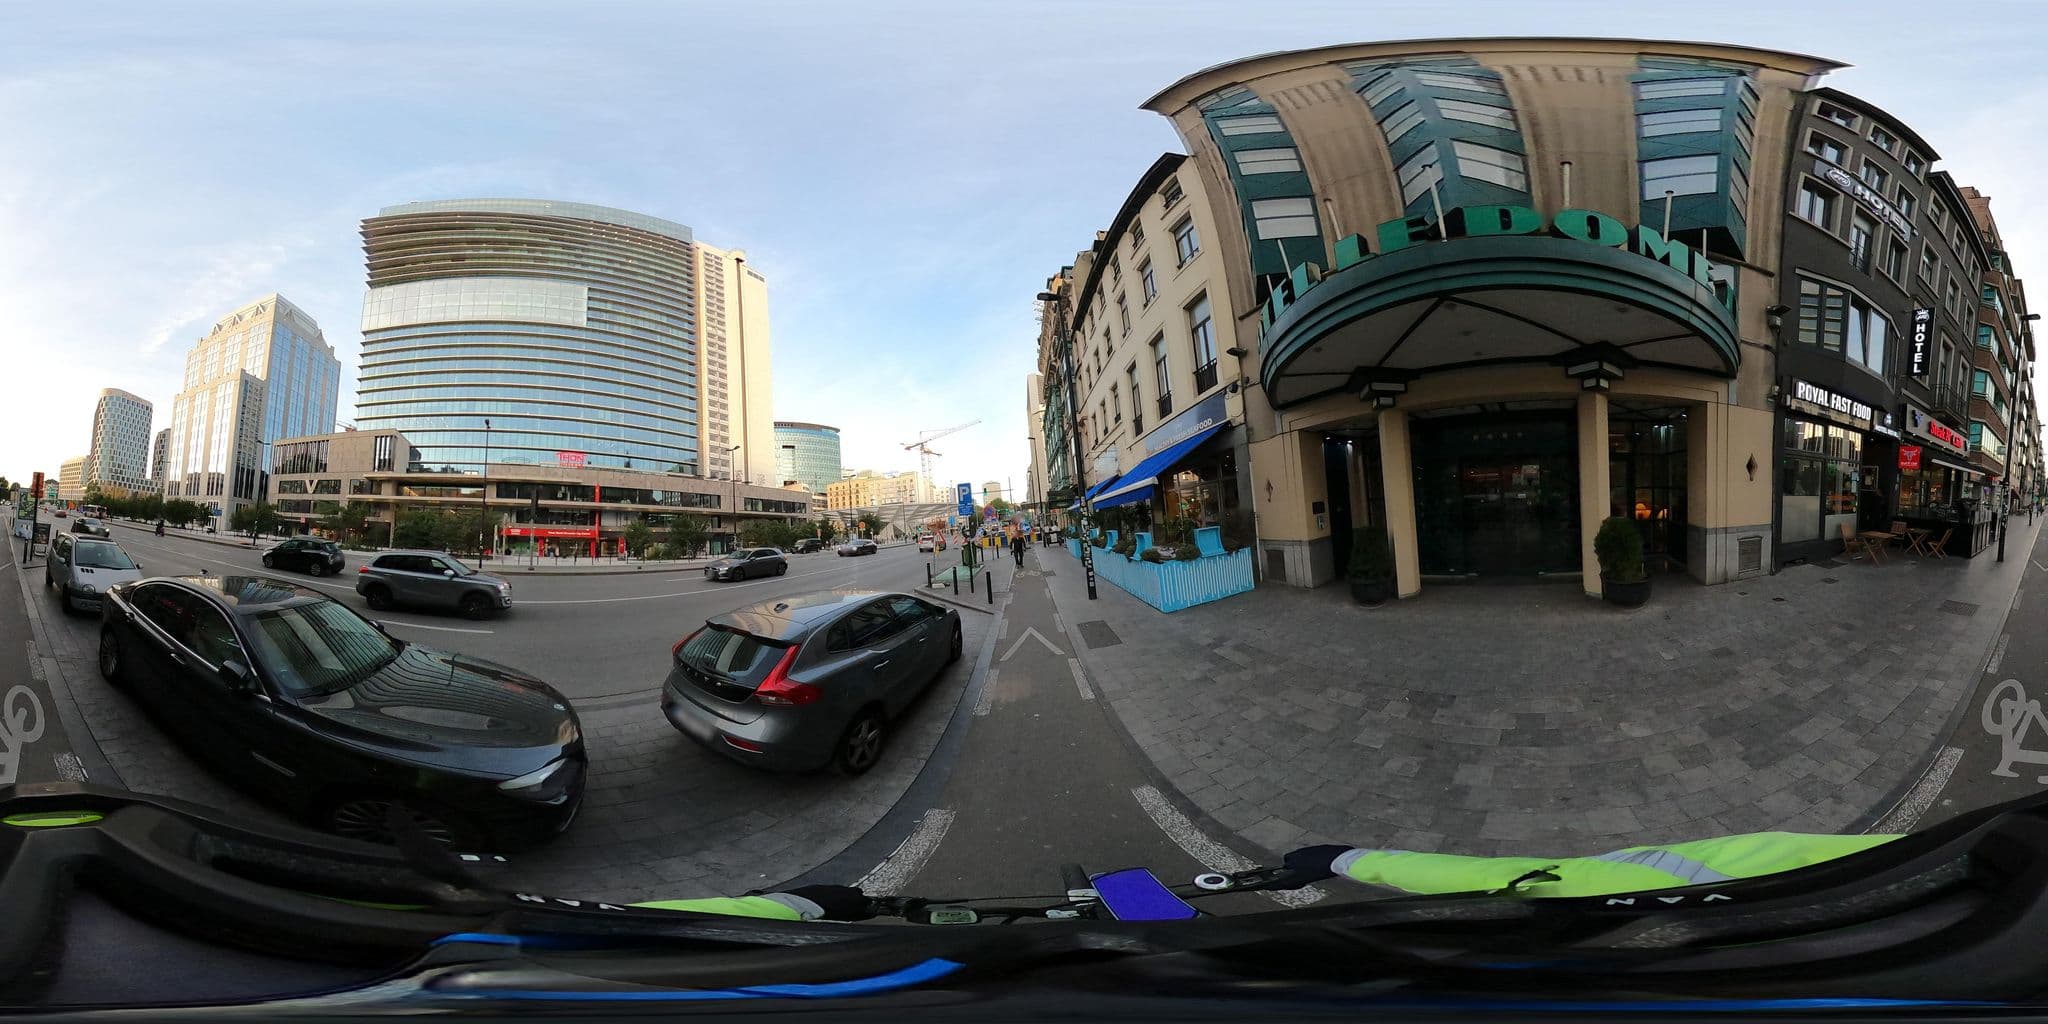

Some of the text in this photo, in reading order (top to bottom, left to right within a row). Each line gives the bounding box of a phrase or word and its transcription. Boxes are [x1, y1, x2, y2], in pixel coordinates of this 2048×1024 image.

[1854, 184, 1906, 234] HOTEL
[1463, 205, 1715, 296] DOME
[1913, 323, 1926, 373] HOTEL
[1797, 381, 1872, 421] ROYAL FAST FOOD
[958, 486, 970, 502] P
